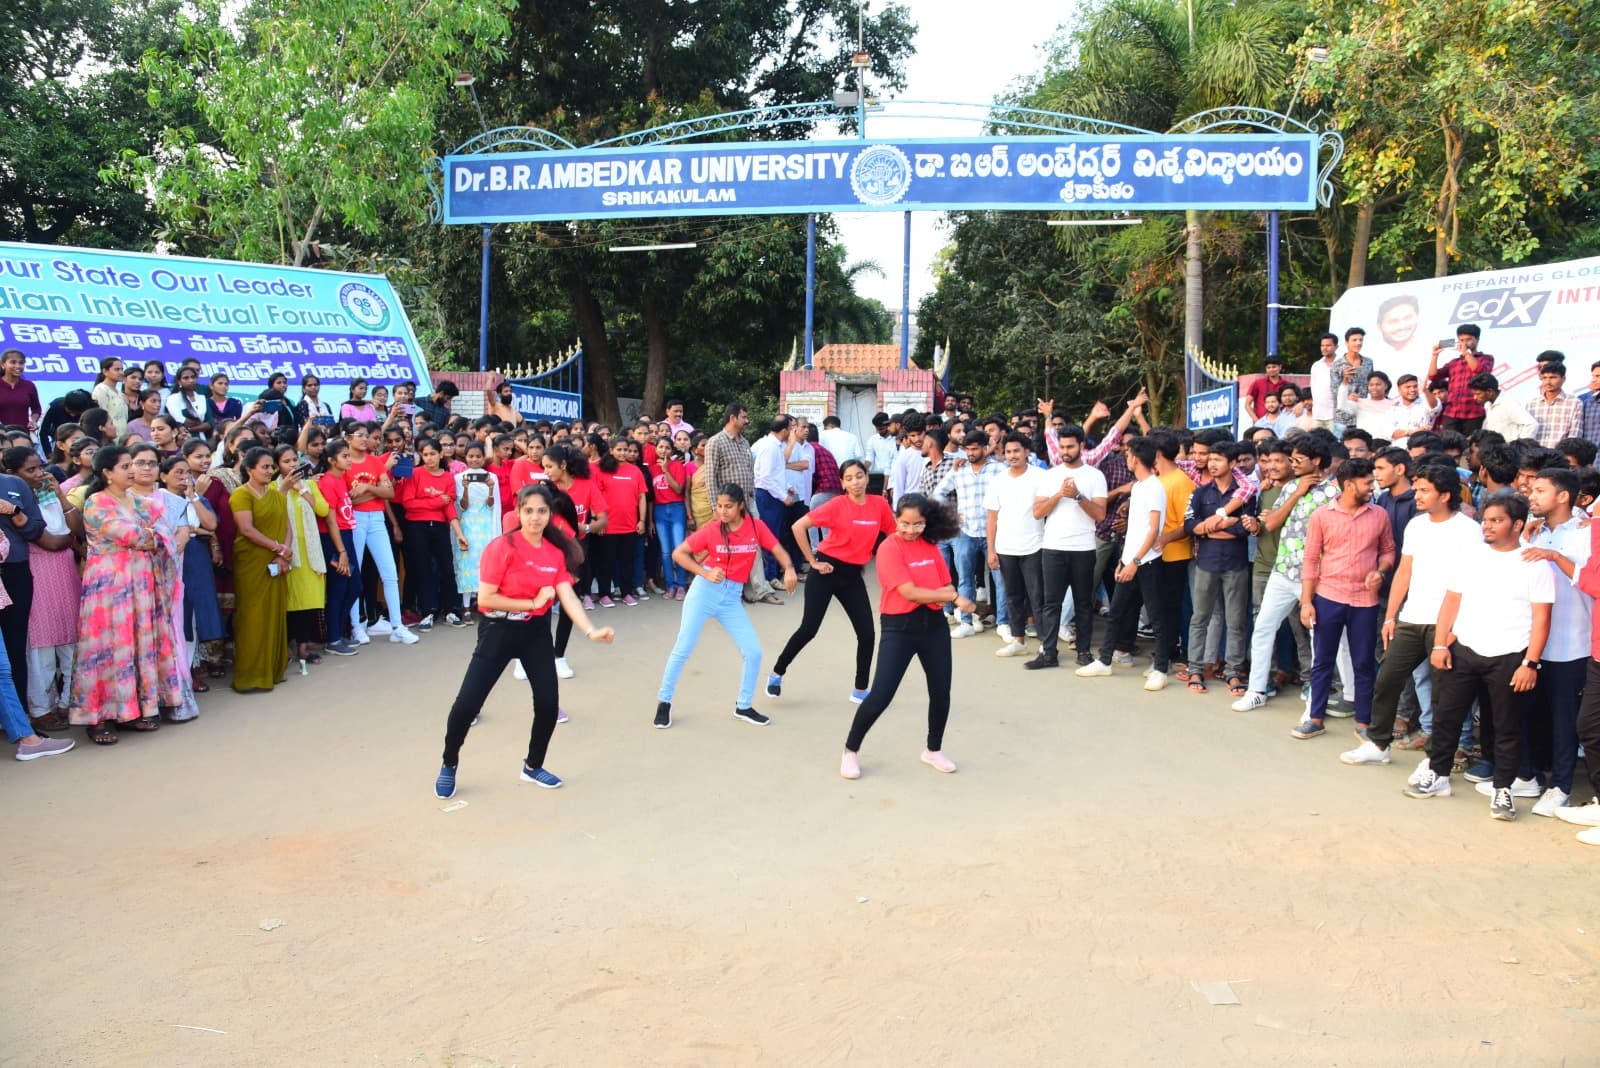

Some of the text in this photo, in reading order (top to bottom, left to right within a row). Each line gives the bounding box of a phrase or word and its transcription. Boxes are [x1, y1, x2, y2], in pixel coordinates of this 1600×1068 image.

[455, 152, 849, 193] Dr.B.R.AMBEDKAR UNIVERSITY
[1016, 143, 1121, 184] అంబేద్కర్
[1133, 146, 1303, 184] విశ్వవిద్యాలయం
[602, 188, 737, 206] SRIKAKULAM
[1060, 180, 1135, 204] శ్రీకాకుళం
[0, 260, 41, 279] ur
[53, 260, 141, 289] State
[152, 270, 207, 292] Our
[217, 274, 313, 298] Leader
[1442, 272, 1545, 292] PREPARING
[1557, 285, 1600, 305] INT
[80, 293, 258, 325] Intellectual
[266, 305, 349, 327] Forum
[10, 323, 83, 350] కొత్త
[188, 335, 237, 353] మన
[240, 334, 309, 355] కోసం,
[312, 337, 353, 354] మన
